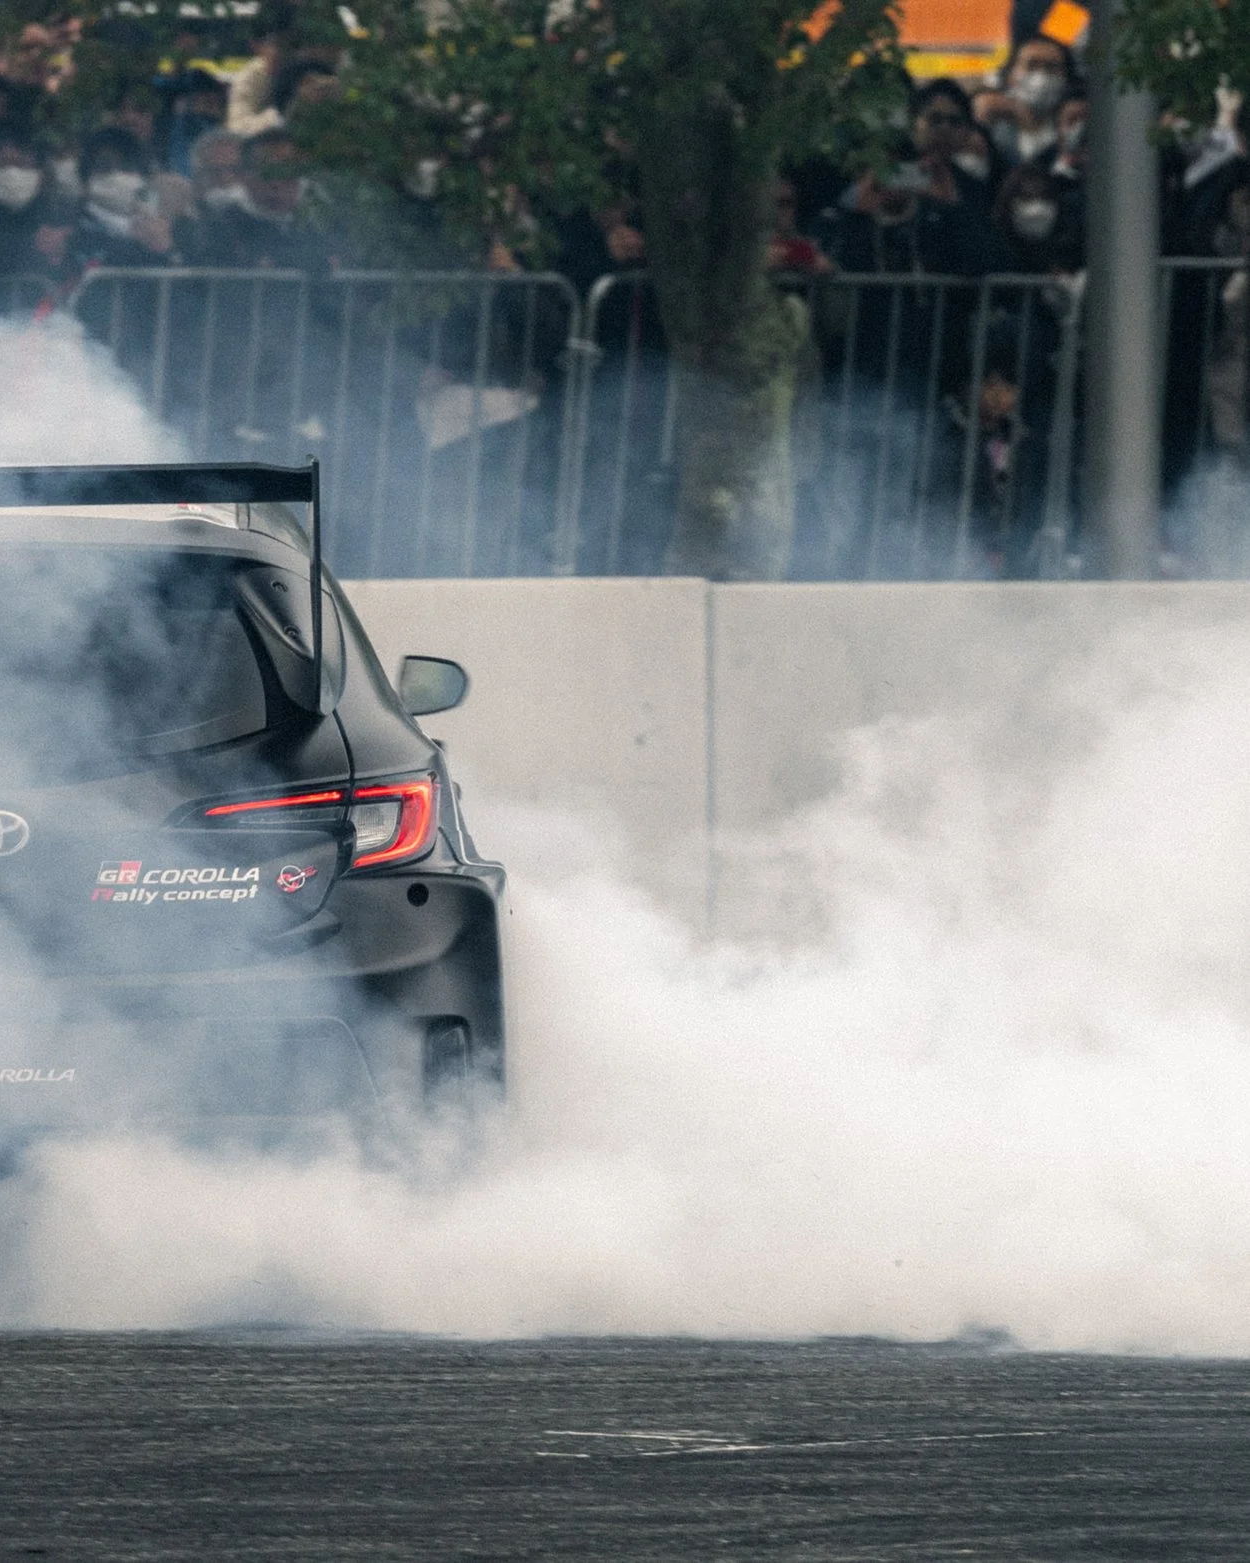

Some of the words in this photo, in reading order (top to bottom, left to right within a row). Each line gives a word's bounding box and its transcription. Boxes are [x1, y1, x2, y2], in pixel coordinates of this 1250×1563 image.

[98, 868, 139, 884] GR
[143, 867, 260, 884] COROLLA
[92, 887, 158, 905] Rally
[163, 885, 259, 902] concept
